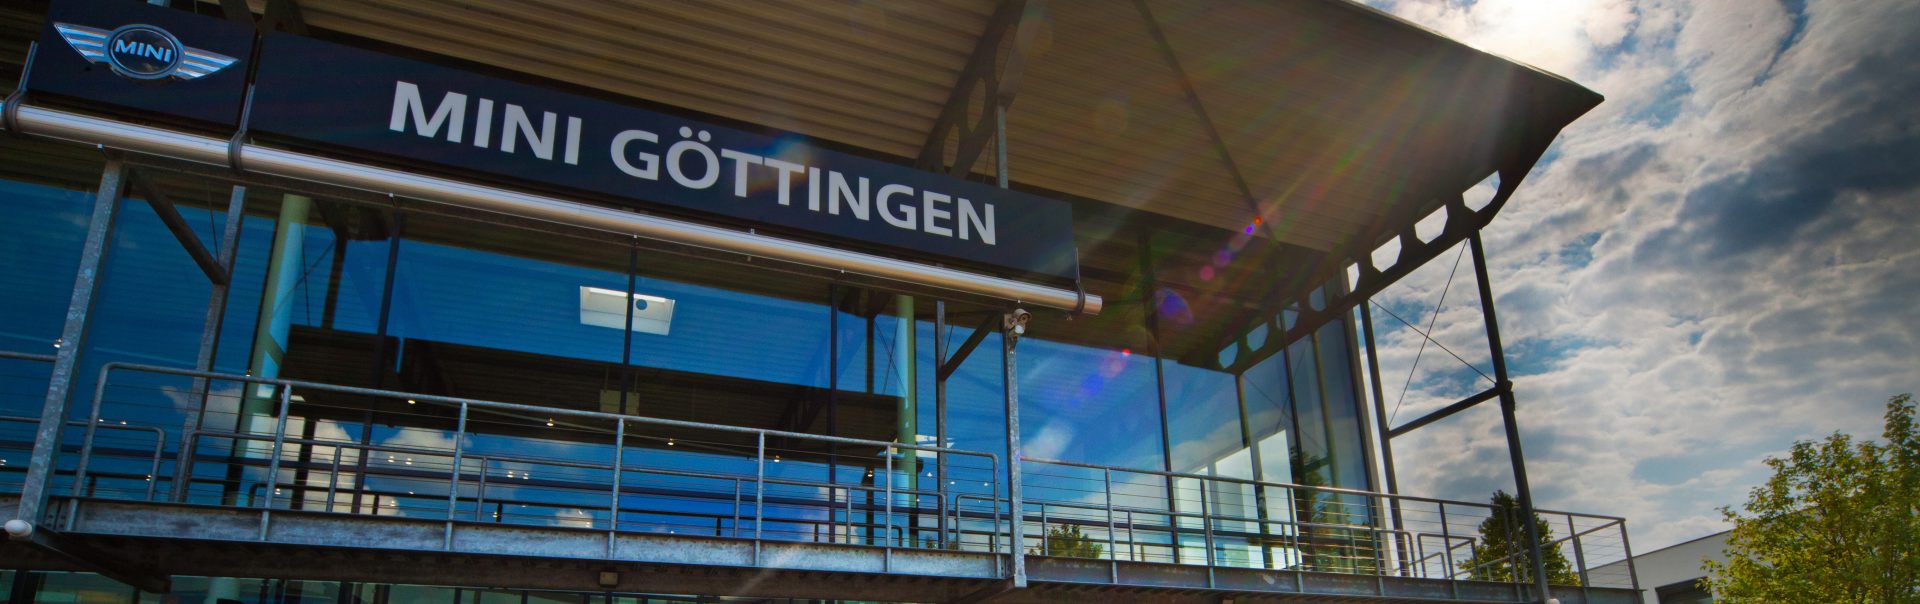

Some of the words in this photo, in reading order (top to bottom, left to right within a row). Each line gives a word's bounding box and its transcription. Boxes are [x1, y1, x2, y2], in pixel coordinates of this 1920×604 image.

[115, 39, 172, 62] MINI
[389, 81, 582, 165] MINI
[610, 126, 996, 246] GÖTTINGEN
